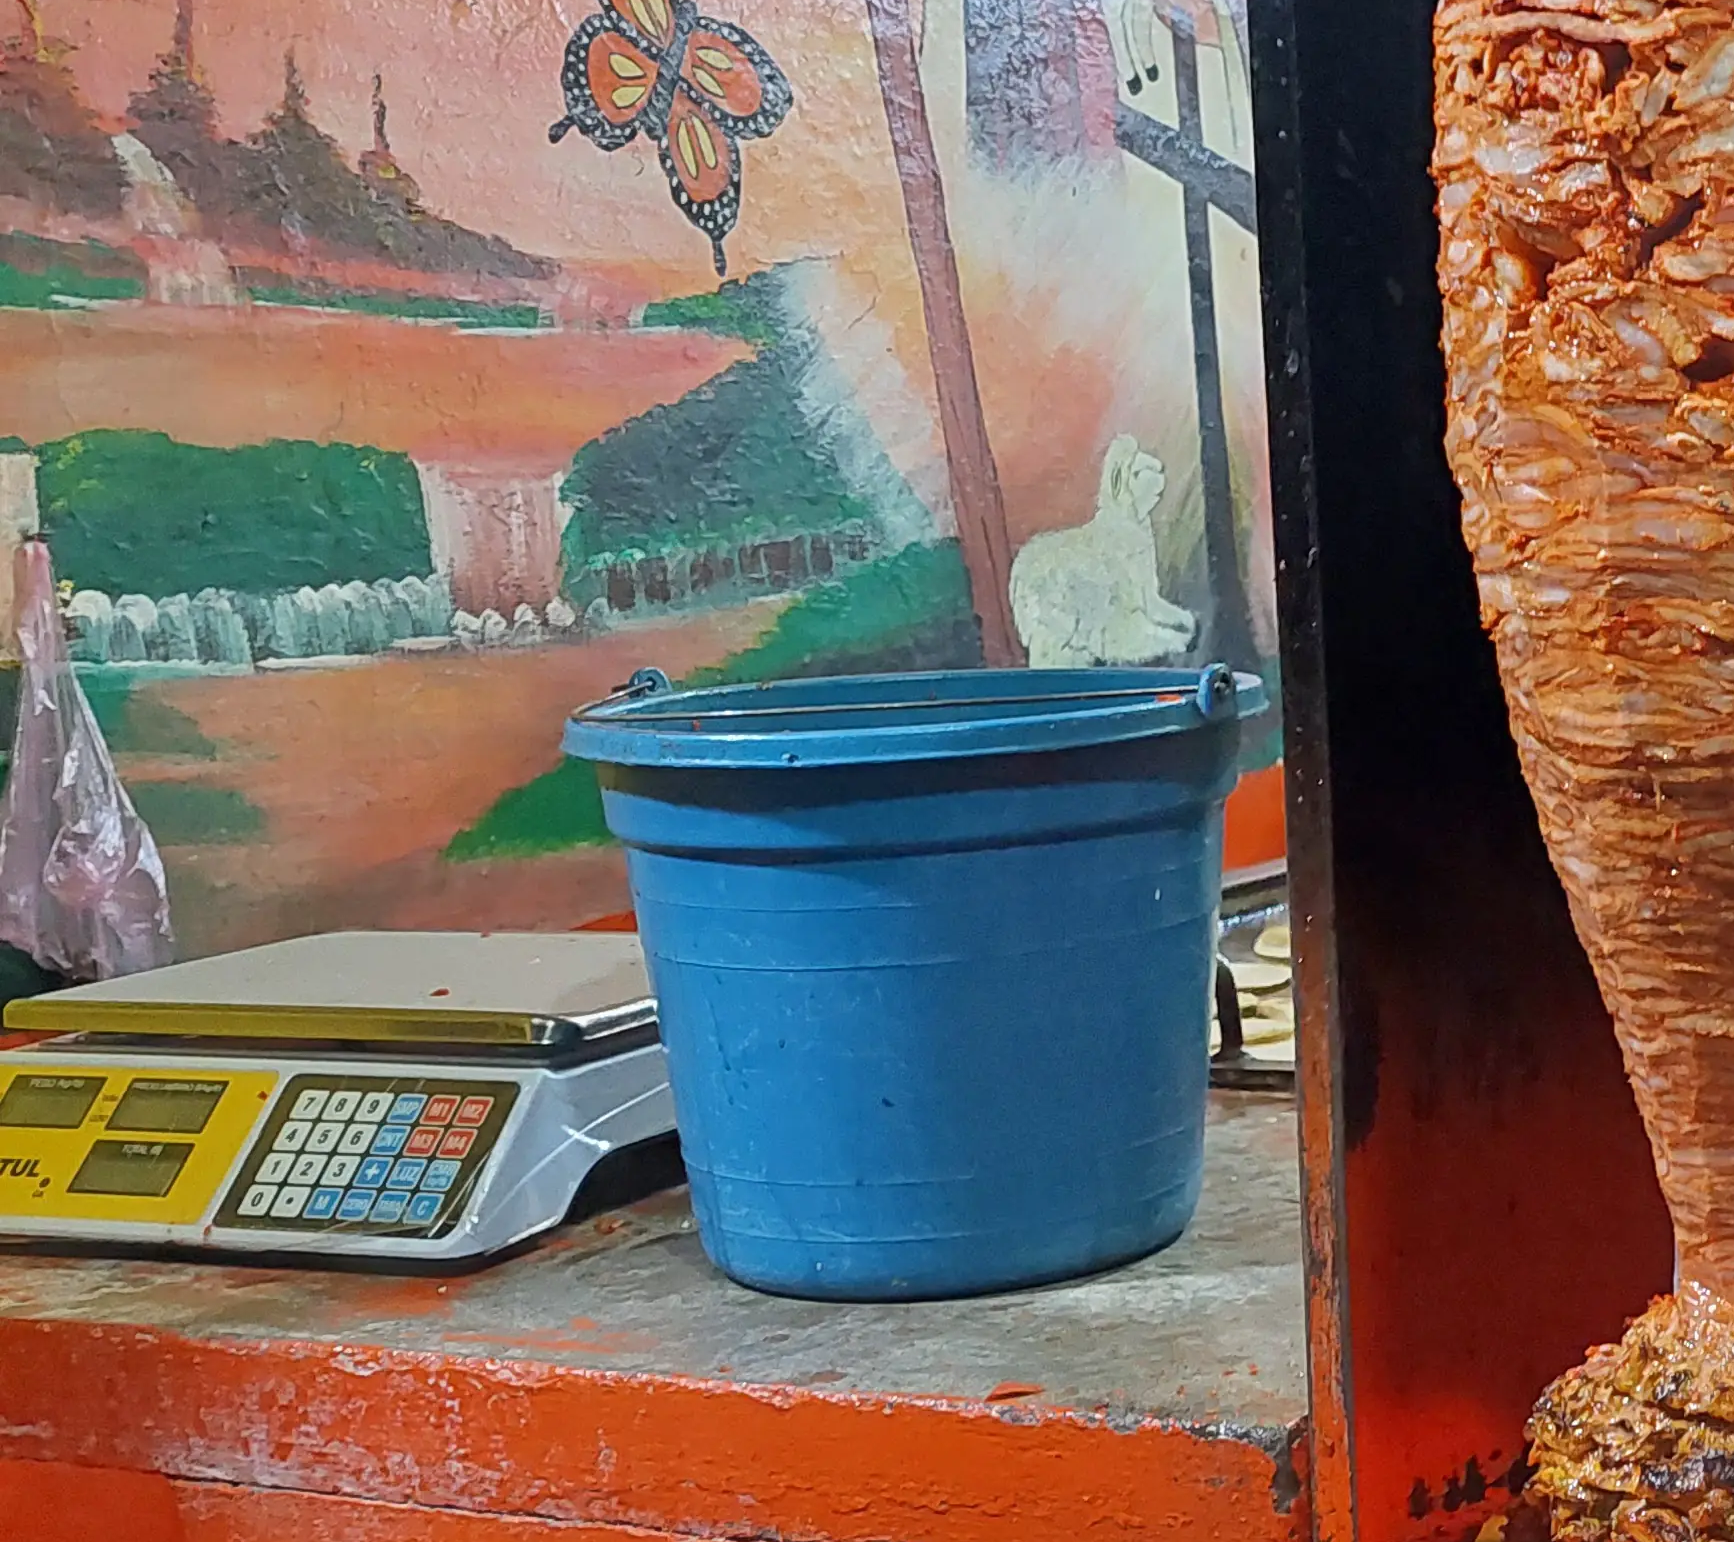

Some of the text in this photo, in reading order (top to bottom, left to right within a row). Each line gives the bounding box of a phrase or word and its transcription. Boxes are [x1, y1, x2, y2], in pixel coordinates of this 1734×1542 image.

[302, 1097, 316, 1111] 7
[334, 1098, 347, 1112] 8
[367, 1099, 380, 1114] 9
[428, 1102, 450, 1117] M1
[461, 1103, 484, 1119] M2
[285, 1128, 298, 1142] 4
[317, 1129, 332, 1144] 5
[350, 1130, 363, 1145] 6
[411, 1133, 434, 1149] M3
[444, 1135, 467, 1150] M4
[0, 1158, 40, 1177] TUL
[270, 1160, 282, 1175] 1
[300, 1161, 313, 1176] 2
[332, 1162, 346, 1177] 3
[250, 1192, 264, 1207] 0
[314, 1195, 330, 1210] M
[417, 1201, 430, 1216] C
